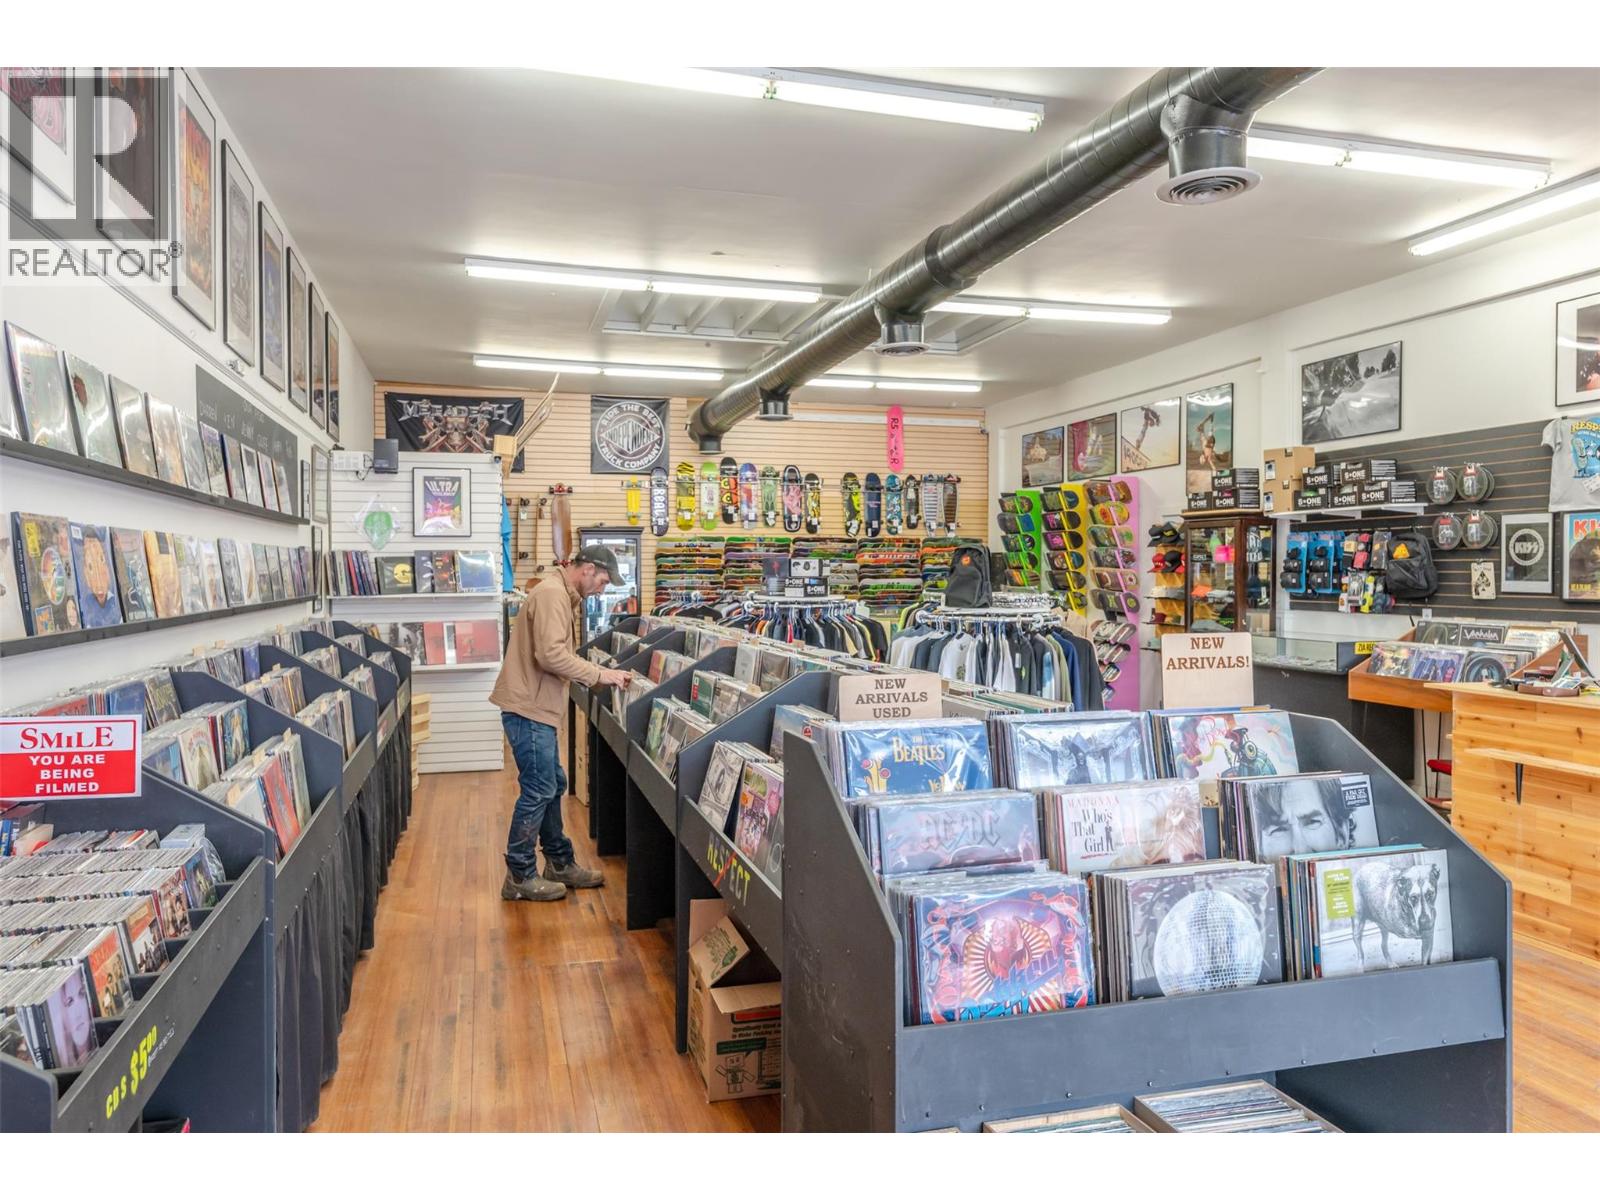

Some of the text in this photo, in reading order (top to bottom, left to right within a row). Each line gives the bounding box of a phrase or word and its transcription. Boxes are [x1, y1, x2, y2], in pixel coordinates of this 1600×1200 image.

[397, 399, 514, 426] MEGADETH
[602, 404, 661, 428] RIDE THE BEST
[599, 441, 661, 468] TRUCK COMPANY
[425, 481, 459, 493] ULTRA
[1515, 542, 1539, 554] KISS
[1190, 636, 1225, 650] NEW
[1166, 656, 1250, 671] ARRIVALS!
[874, 678, 907, 690] NEW
[855, 692, 928, 705] ARRIVALS
[872, 706, 911, 719] USED
[893, 737, 945, 765] BEATLES
[29, 754, 106, 766] YOU ARE
[40, 768, 95, 780] BEING
[35, 782, 100, 794] FILMED
[1067, 795, 1120, 808] MADONNA
[1081, 808, 1113, 823] Who's
[1071, 821, 1095, 837] That
[1084, 838, 1105, 854] Girl
